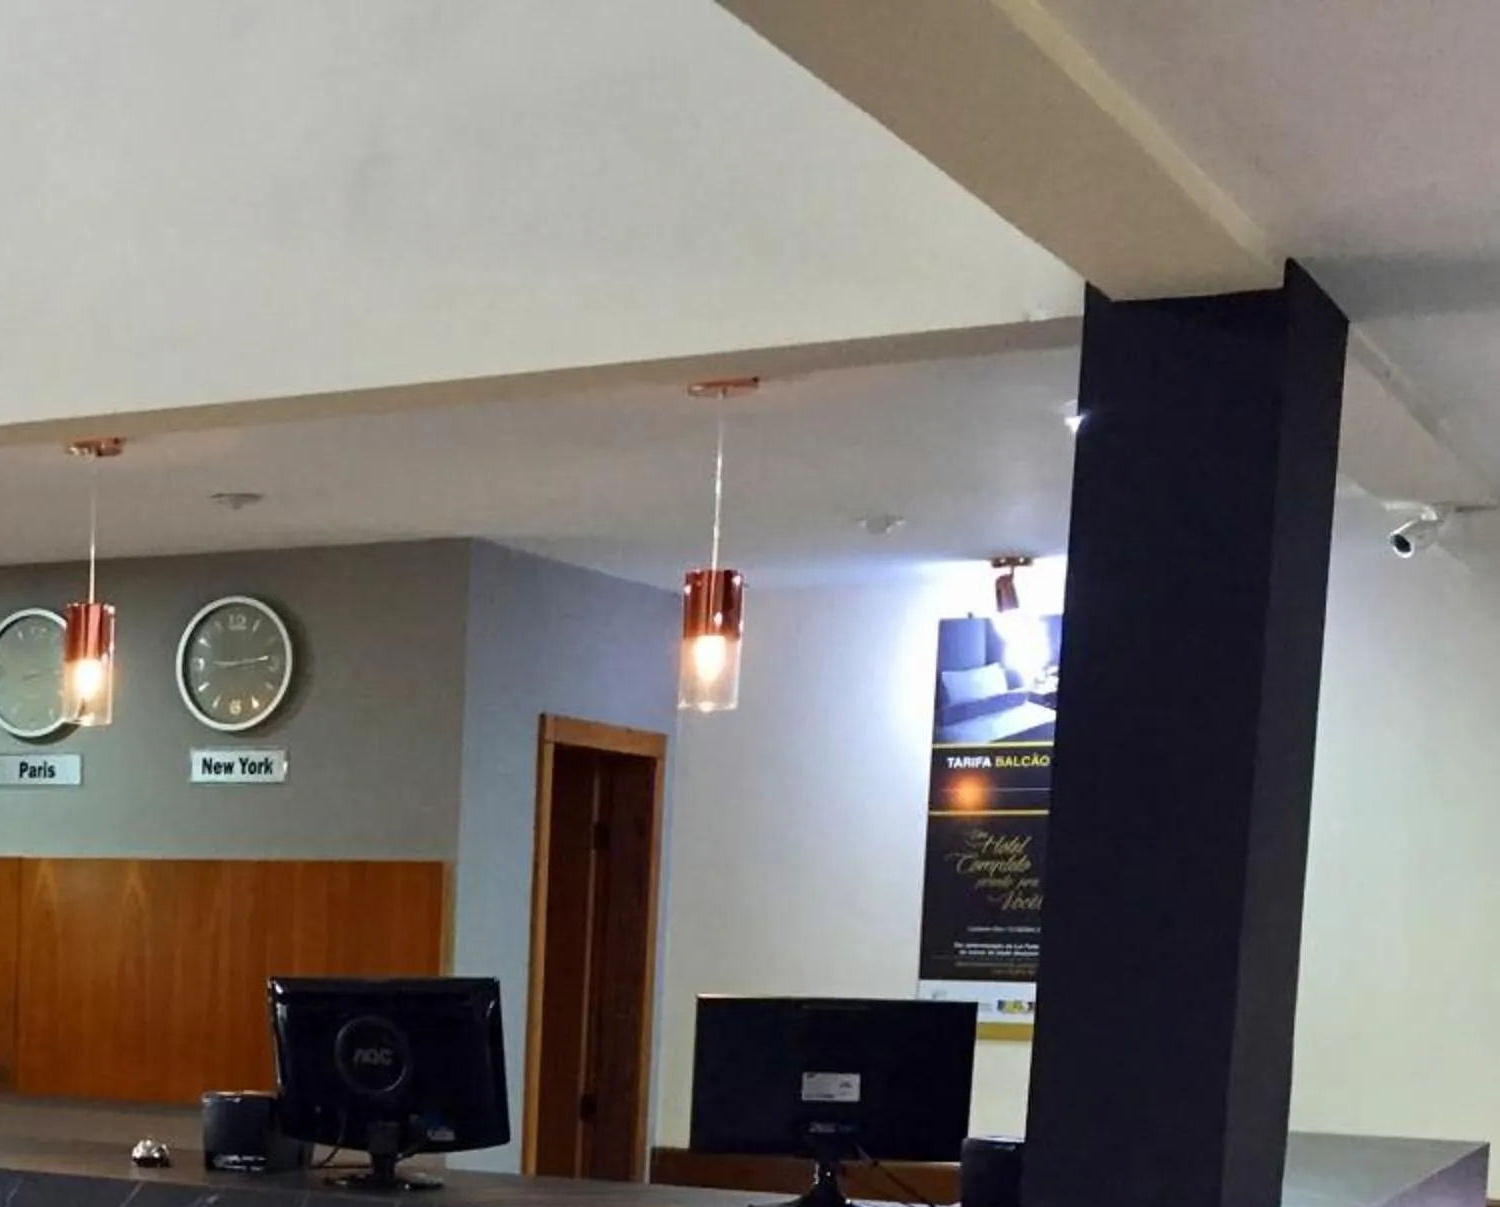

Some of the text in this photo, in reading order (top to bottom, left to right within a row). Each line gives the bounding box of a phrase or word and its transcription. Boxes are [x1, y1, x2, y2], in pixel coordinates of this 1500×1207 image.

[201, 757, 273, 775] New York
[947, 752, 1052, 769] TARIFA BALCÃO
[18, 761, 56, 779] Paris
[353, 1047, 394, 1066] AOC
